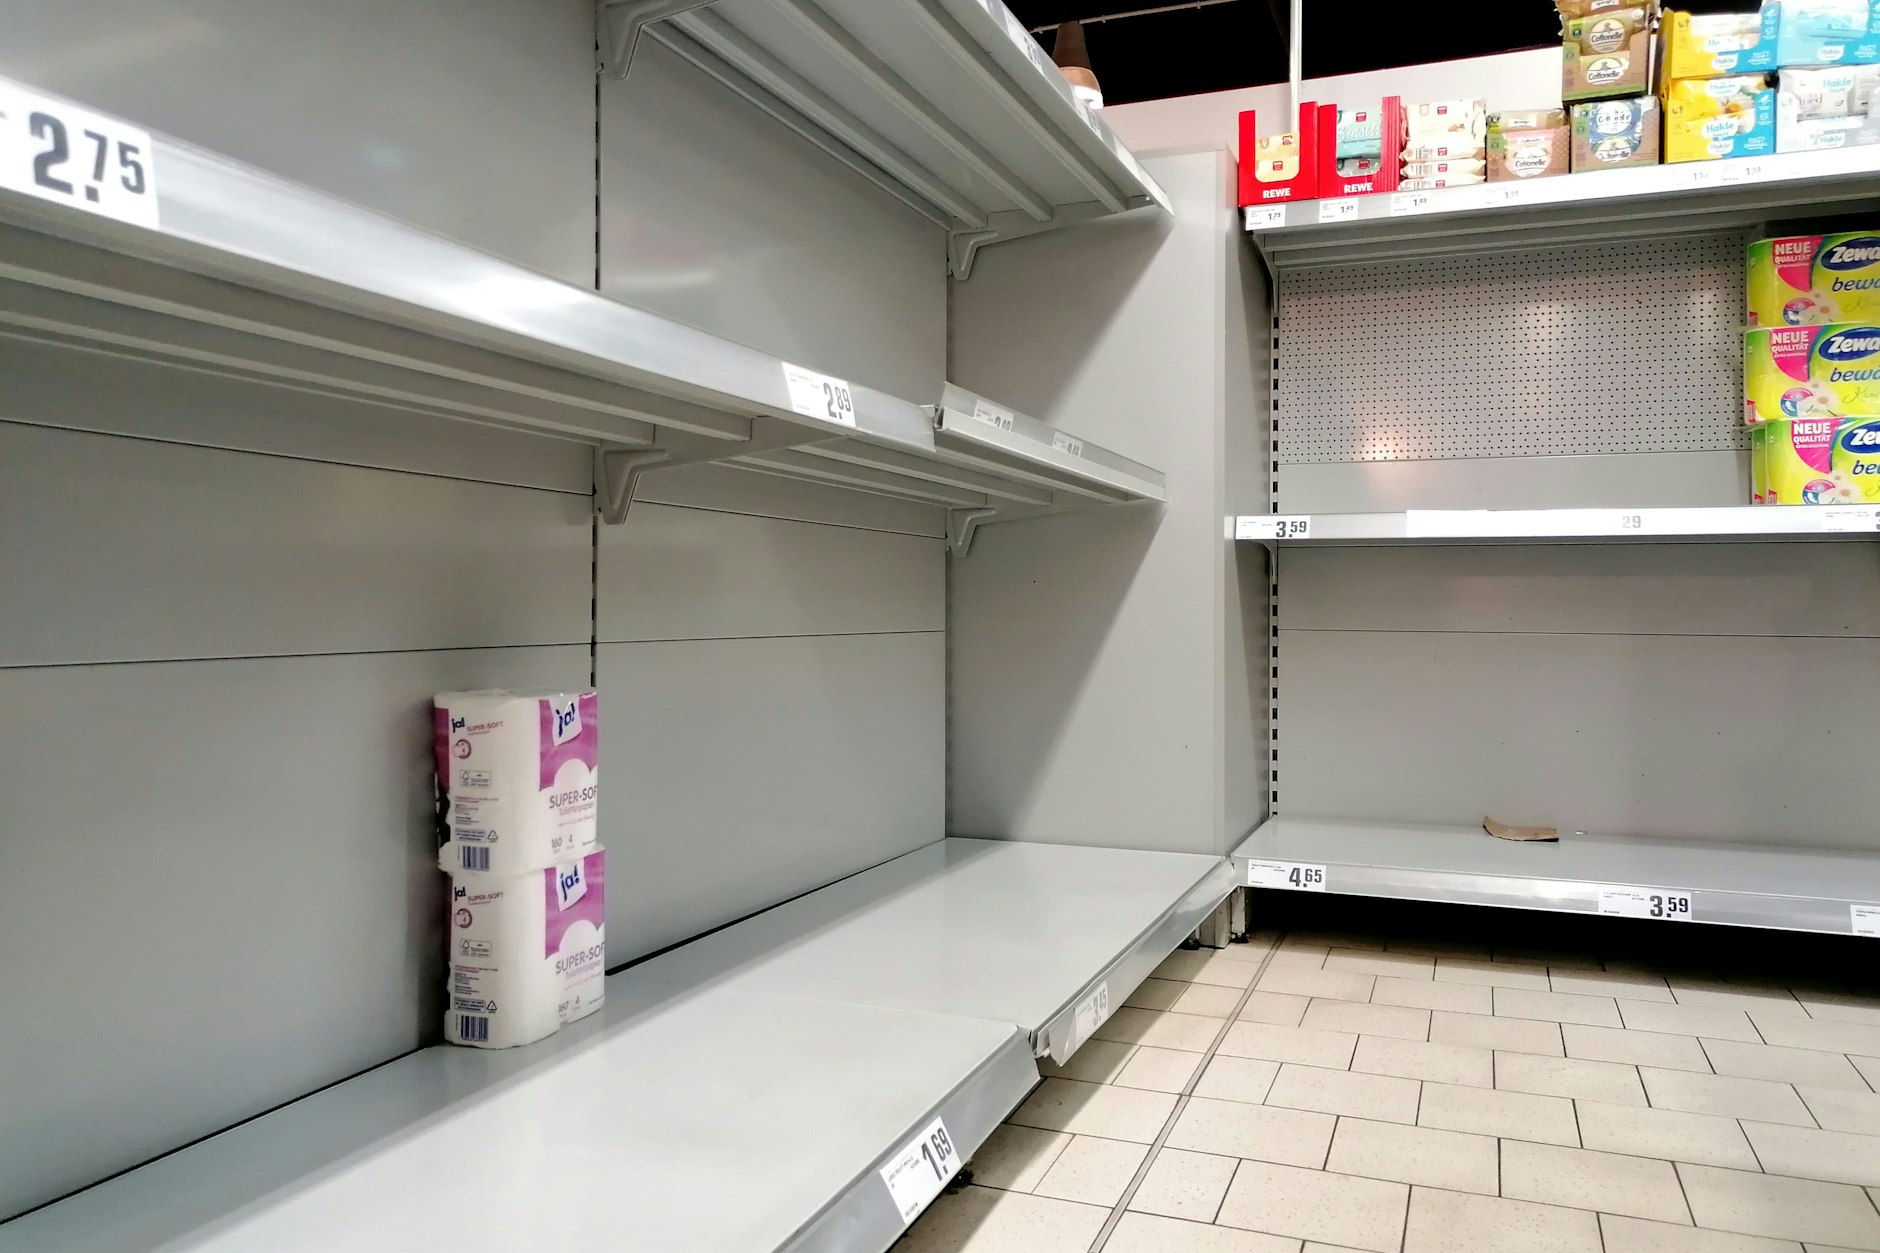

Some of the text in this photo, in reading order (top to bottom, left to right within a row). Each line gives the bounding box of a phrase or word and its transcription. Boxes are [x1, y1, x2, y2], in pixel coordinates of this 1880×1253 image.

[1706, 121, 1734, 133] Hakle
[29, 111, 146, 204] 2.75
[1262, 187, 1291, 199] REWE
[1343, 182, 1373, 194] REWE
[1774, 241, 1812, 255] NEUE
[1774, 253, 1812, 265] QUALITÄT
[1772, 330, 1809, 344] NEUE
[1772, 342, 1810, 354] QUALITÄT
[1827, 336, 1880, 353] Zewa
[823, 382, 851, 420] 2.89
[1793, 422, 1832, 435] NEUE
[1793, 433, 1832, 445] QUALITÄT
[1275, 520, 1307, 538] 3.59
[451, 717, 465, 733] ja!
[466, 721, 504, 733] SUPER-SOFT
[555, 702, 576, 739] ja!
[551, 836, 563, 849] 160
[560, 864, 580, 903] ja!
[1288, 867, 1322, 888] 4.65
[454, 886, 467, 902] ja!
[467, 891, 504, 903] SUPER-SOFT
[1649, 895, 1689, 918] 3.59
[558, 1000, 569, 1013] 160
[921, 1126, 952, 1182] 1.69
